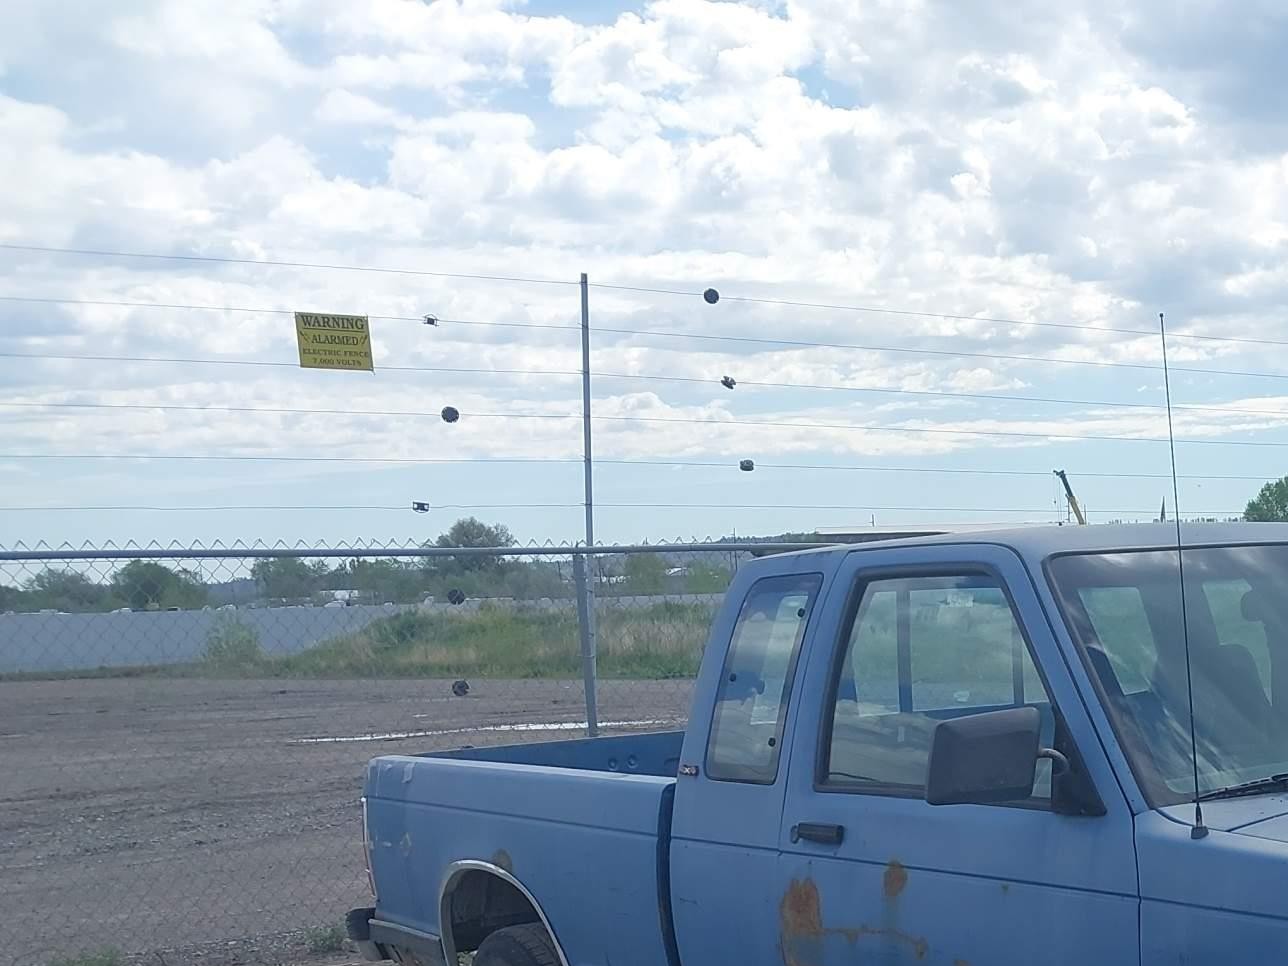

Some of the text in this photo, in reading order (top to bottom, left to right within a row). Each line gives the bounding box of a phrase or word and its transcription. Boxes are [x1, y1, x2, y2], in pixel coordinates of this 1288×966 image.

[301, 315, 364, 329] WARNING
[311, 334, 359, 345] ALARMED
[302, 348, 369, 358] ELECTRIC FENCE
[336, 358, 362, 366] VOLTS
